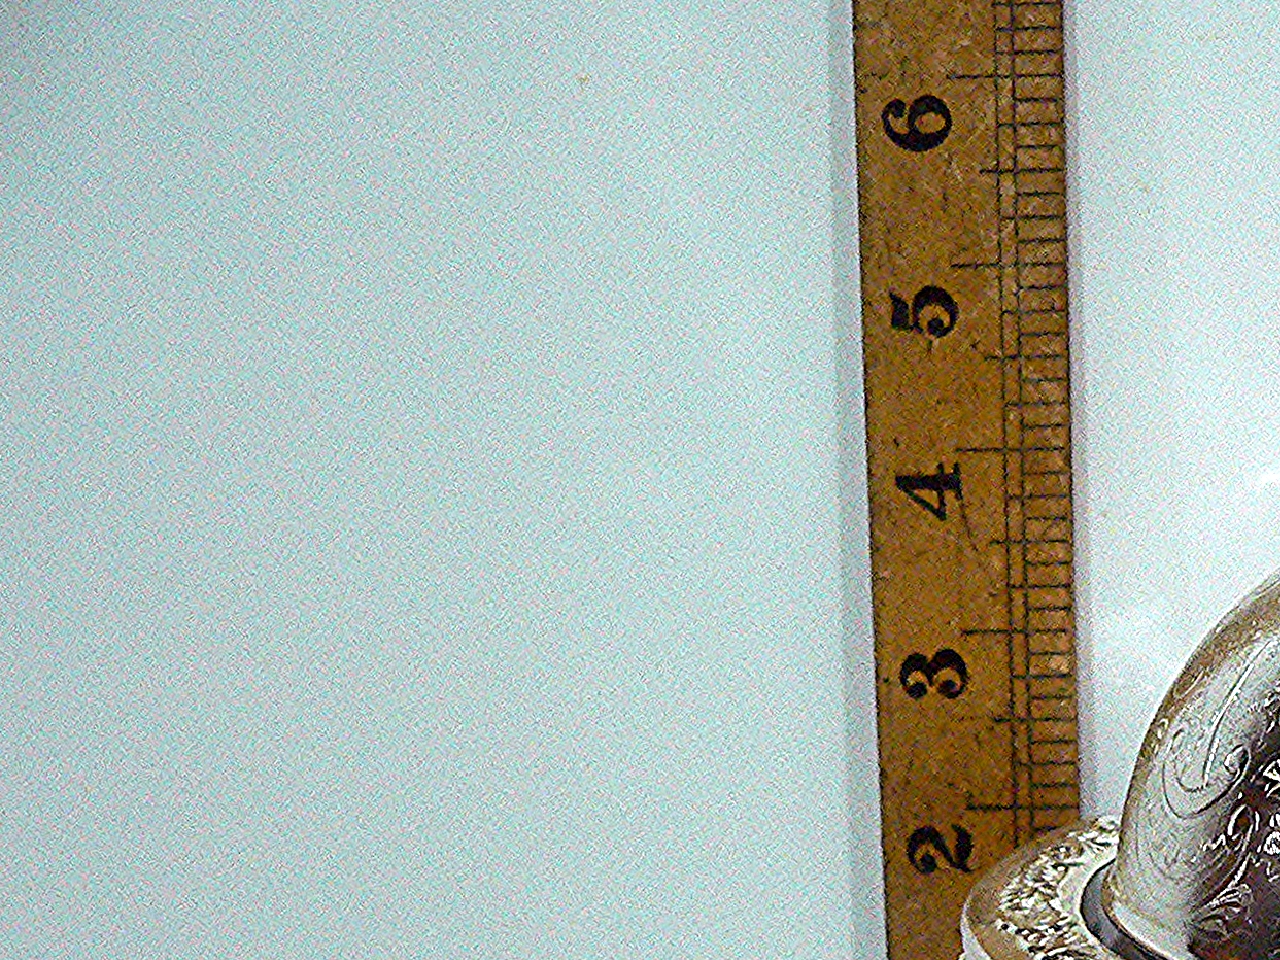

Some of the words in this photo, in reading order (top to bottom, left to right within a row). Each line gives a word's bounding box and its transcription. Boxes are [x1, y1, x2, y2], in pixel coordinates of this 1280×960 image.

[882, 95, 952, 151] 6
[889, 285, 958, 338] 5
[895, 461, 963, 520] 4
[900, 649, 968, 699] 3
[907, 824, 974, 873] 2
